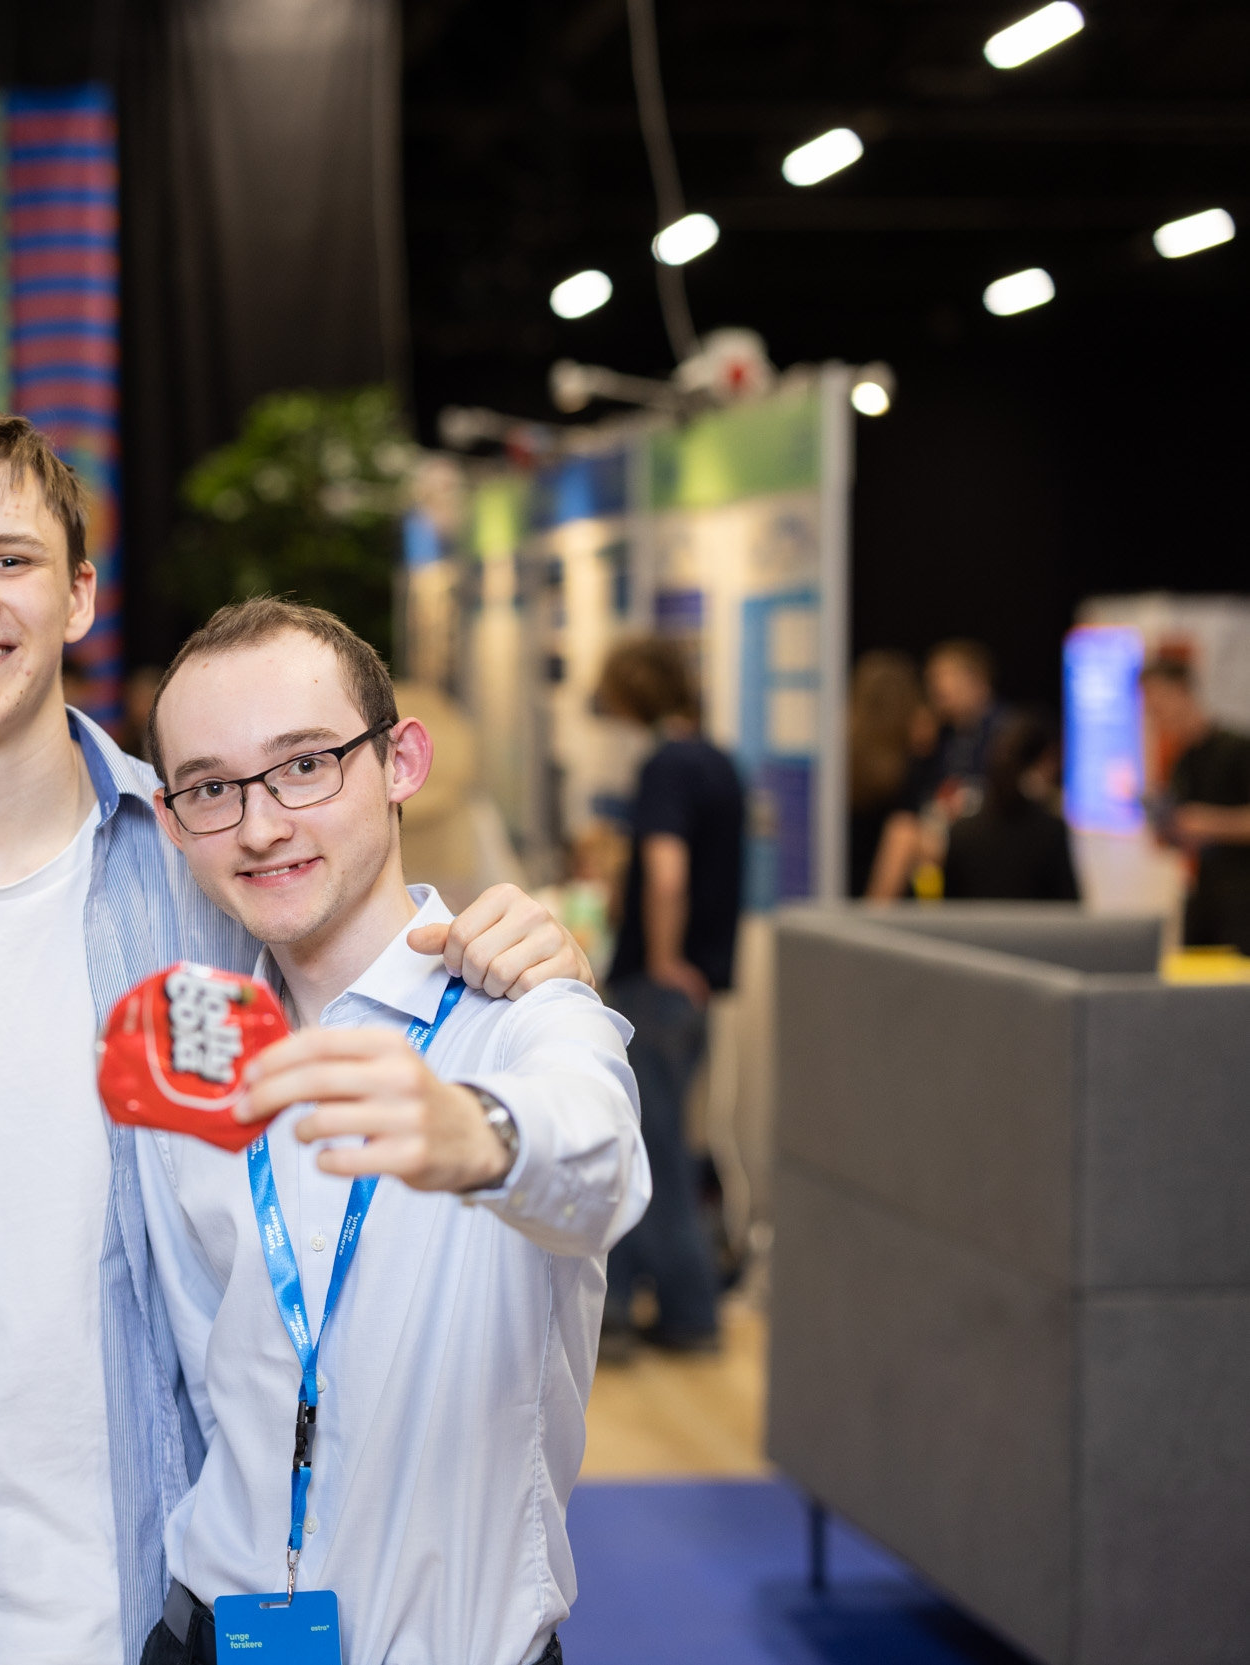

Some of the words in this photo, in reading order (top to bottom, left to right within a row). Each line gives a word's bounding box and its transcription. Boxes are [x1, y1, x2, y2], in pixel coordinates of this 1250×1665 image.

[269, 1205, 285, 1247] forskere
[338, 1214, 353, 1256] forskere
[293, 1303, 309, 1345] forskere
[230, 1640, 263, 1649] forskere
